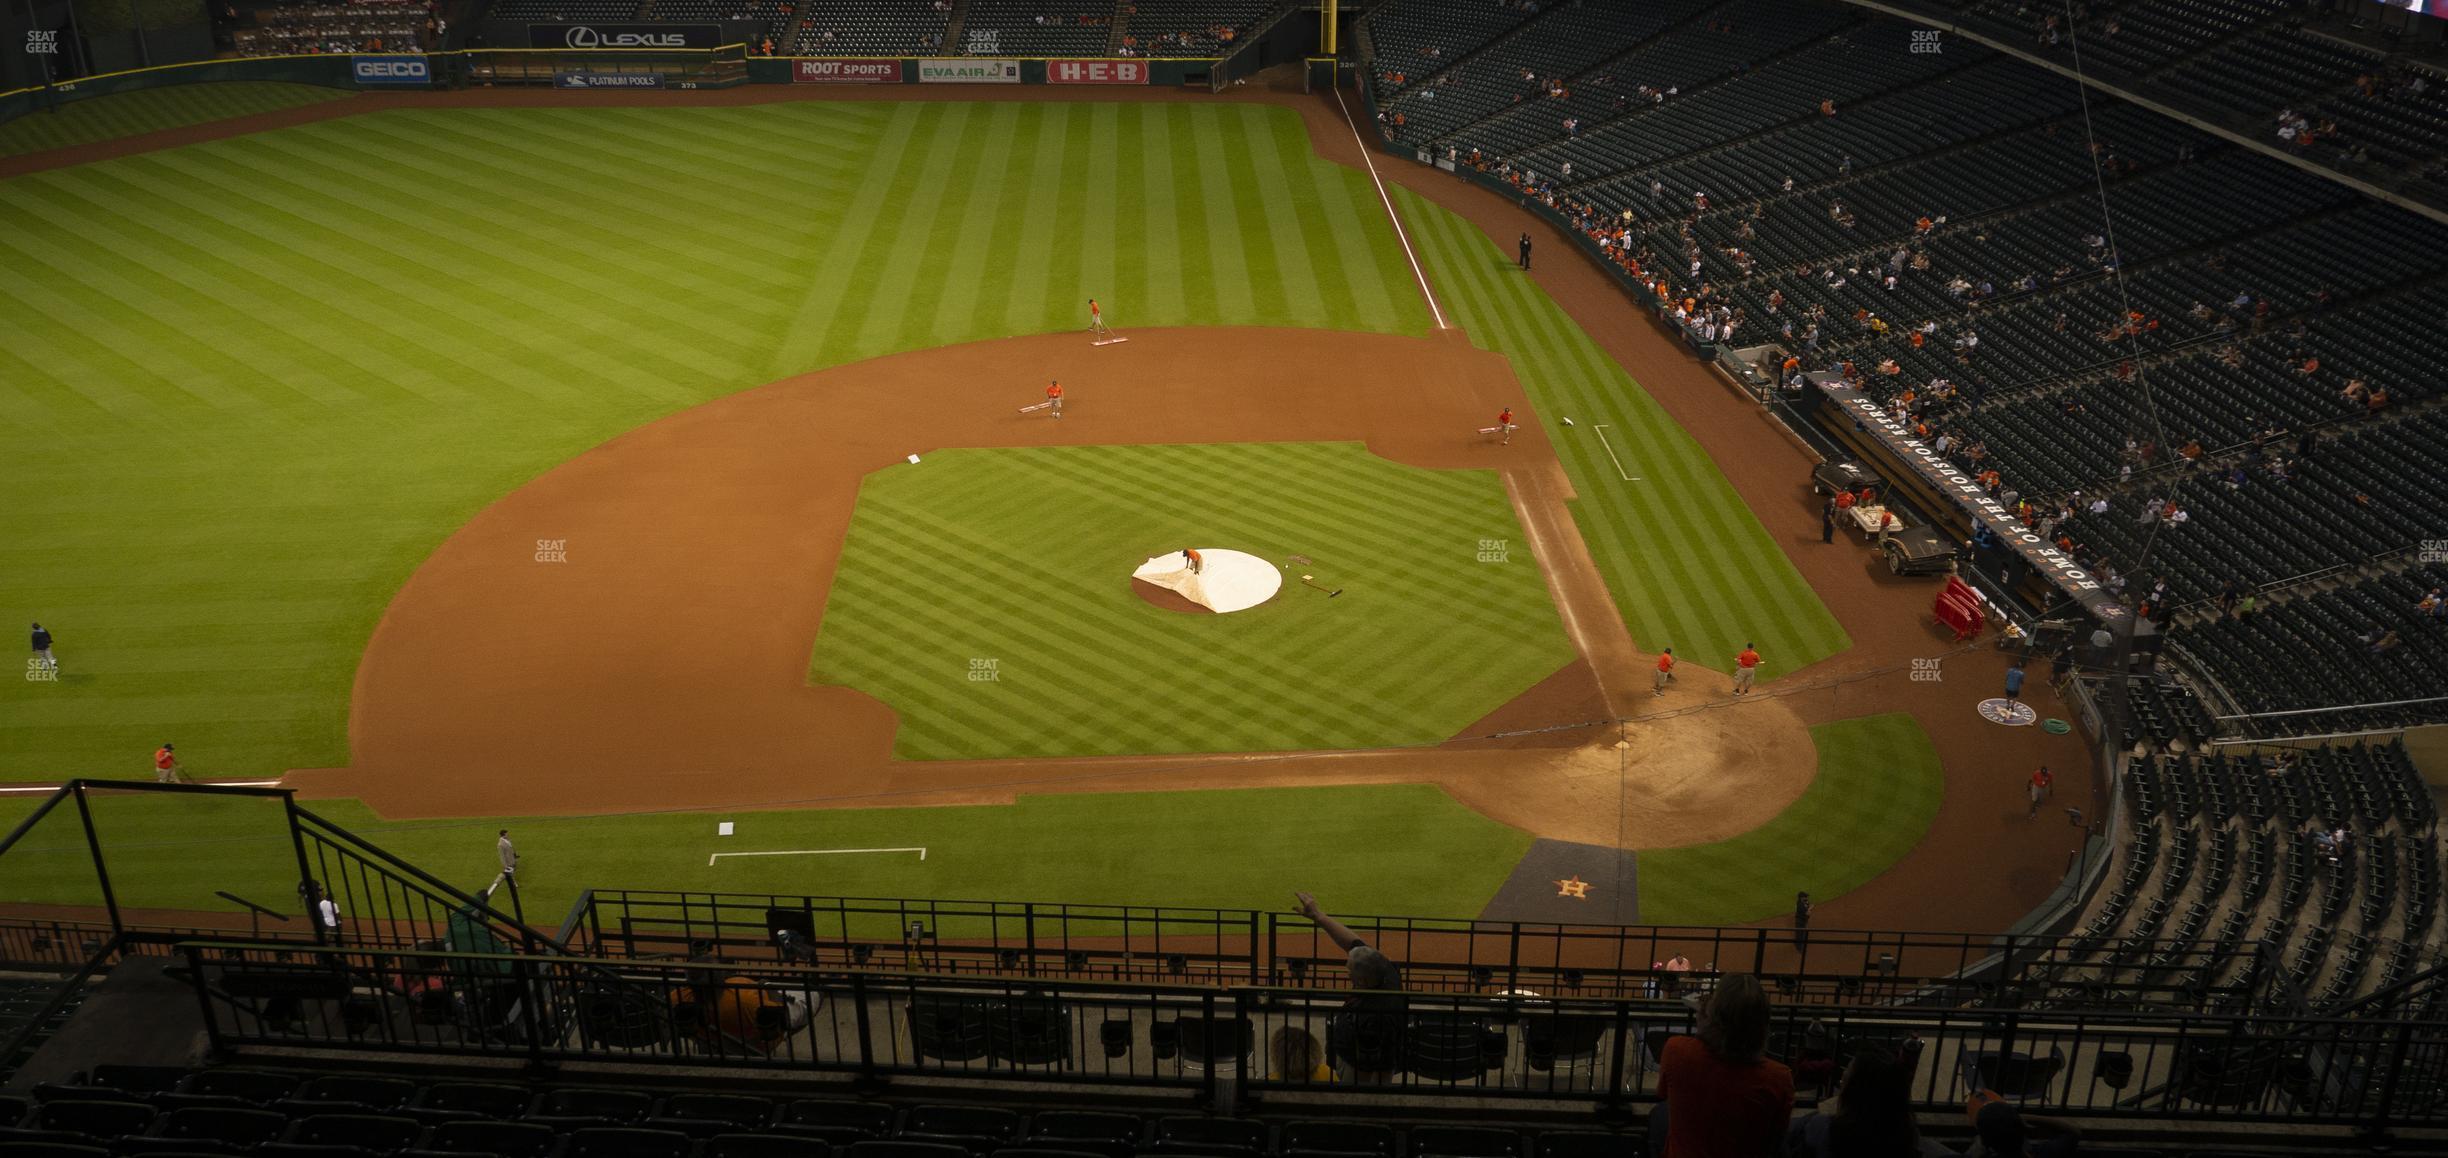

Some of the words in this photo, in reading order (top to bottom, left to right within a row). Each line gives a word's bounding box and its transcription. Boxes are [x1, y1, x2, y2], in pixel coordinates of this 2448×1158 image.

[602, 33, 686, 47] LEXUS
[356, 61, 425, 77] GEICO
[802, 62, 842, 74] ROOT
[844, 65, 891, 74] SPORTS
[923, 68, 957, 76] EVA
[958, 68, 984, 76] AIR
[589, 77, 627, 86] PLATINUM
[629, 77, 655, 86] POOLS
[1851, 397, 1908, 436] ASTROS
[1902, 439, 1981, 493] HOUSTON
[1973, 497, 2015, 521] THE
[2008, 523, 2041, 542] OF
[2037, 548, 2100, 589] HOME
[1558, 880, 1588, 898] H
